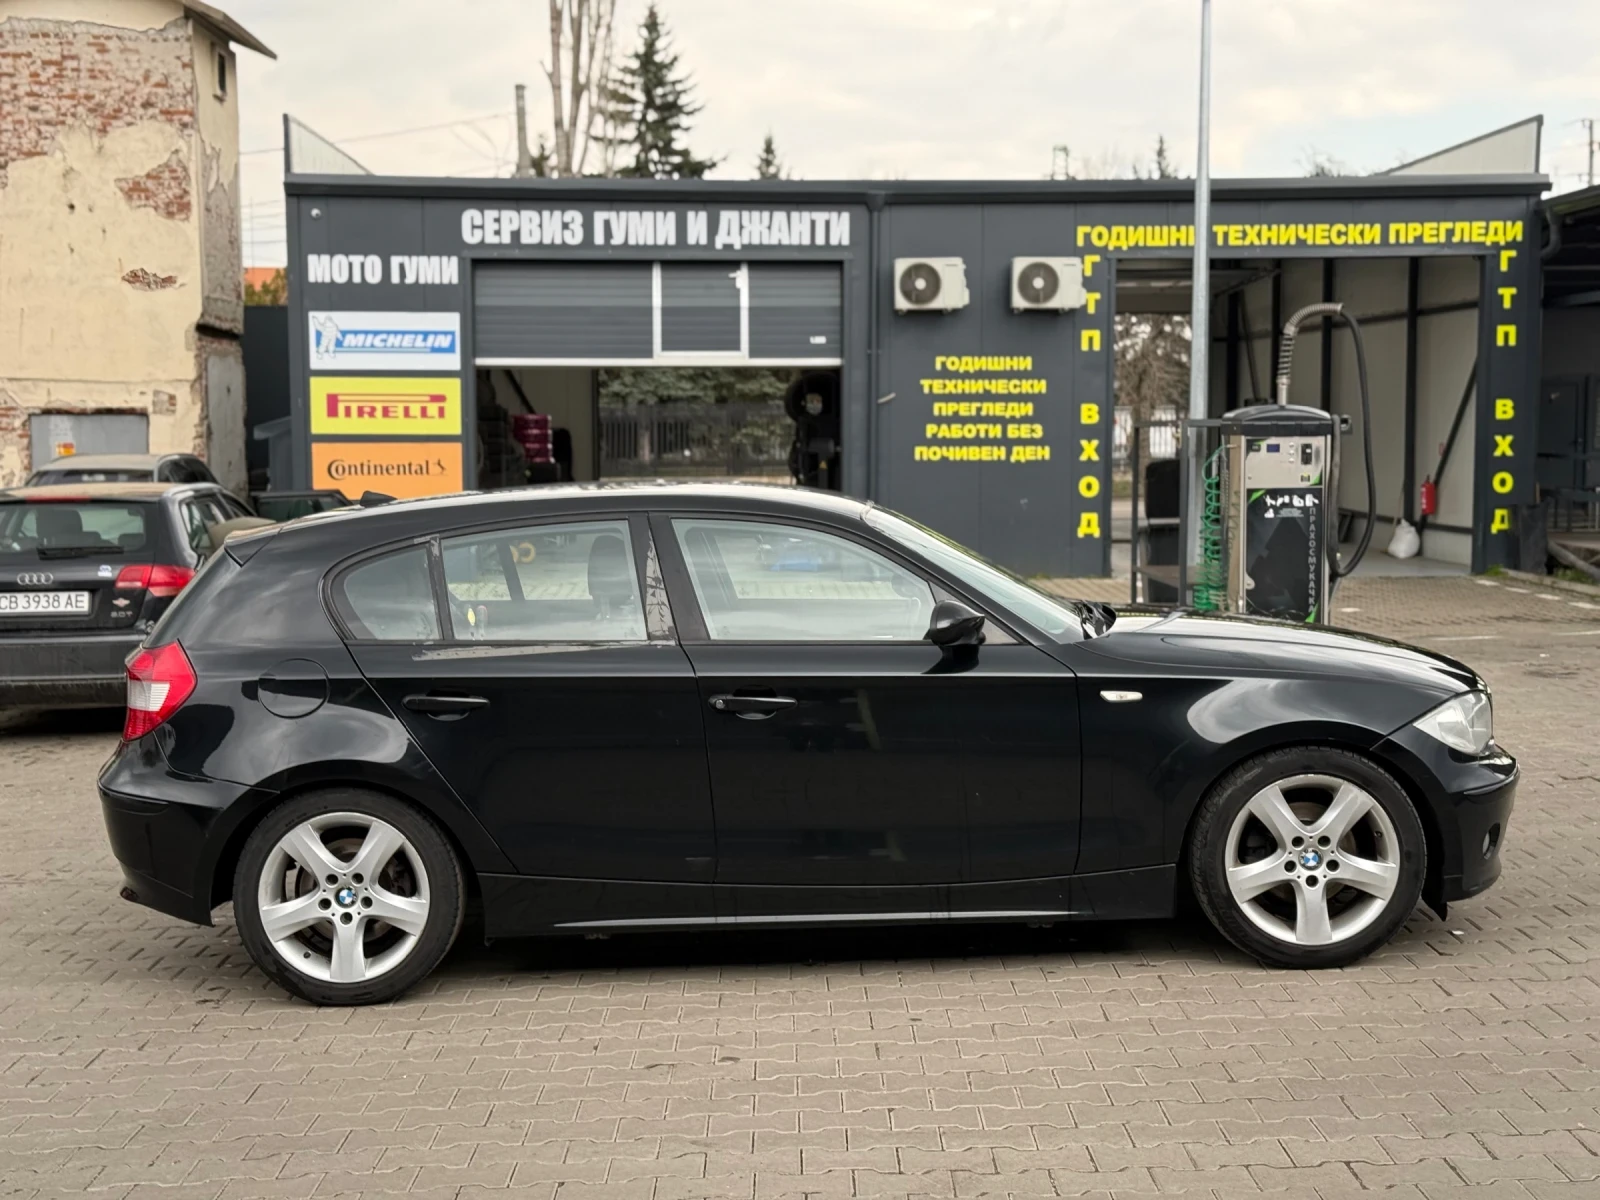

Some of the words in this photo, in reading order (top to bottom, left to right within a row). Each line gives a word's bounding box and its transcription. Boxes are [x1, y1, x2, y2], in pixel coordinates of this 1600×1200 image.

[461, 208, 584, 246] СЕРВИЗ
[593, 210, 677, 246] ГУМИ
[687, 210, 708, 246] И
[715, 210, 850, 250] ДЖАНТИ
[1212, 223, 1382, 246] ТЕХНИЧЕСКИ
[1389, 220, 1524, 246] ПРЕГЛЕДИ
[307, 254, 383, 284] МОТО
[390, 255, 459, 285] ГУМИ
[1496, 250, 1517, 347] ГТП
[342, 333, 453, 348] MICHELIN
[935, 356, 1033, 373] ГОДИШНИ
[920, 379, 1047, 394] ТЕХНИЧЕСКИ
[326, 393, 447, 419] PIRELLI
[933, 402, 1034, 419] ПРЕГЛЕДИ
[926, 423, 1002, 439] РАБОТИ
[1007, 423, 1044, 439] БЕЗ
[914, 445, 1007, 461] ПОЧИВЕН
[1010, 445, 1051, 463] ДЕН
[327, 458, 430, 481] Continental
[1077, 403, 1101, 539] ВХОД
[1491, 398, 1515, 534] ВХОД
[22, 593, 61, 610] 3938
